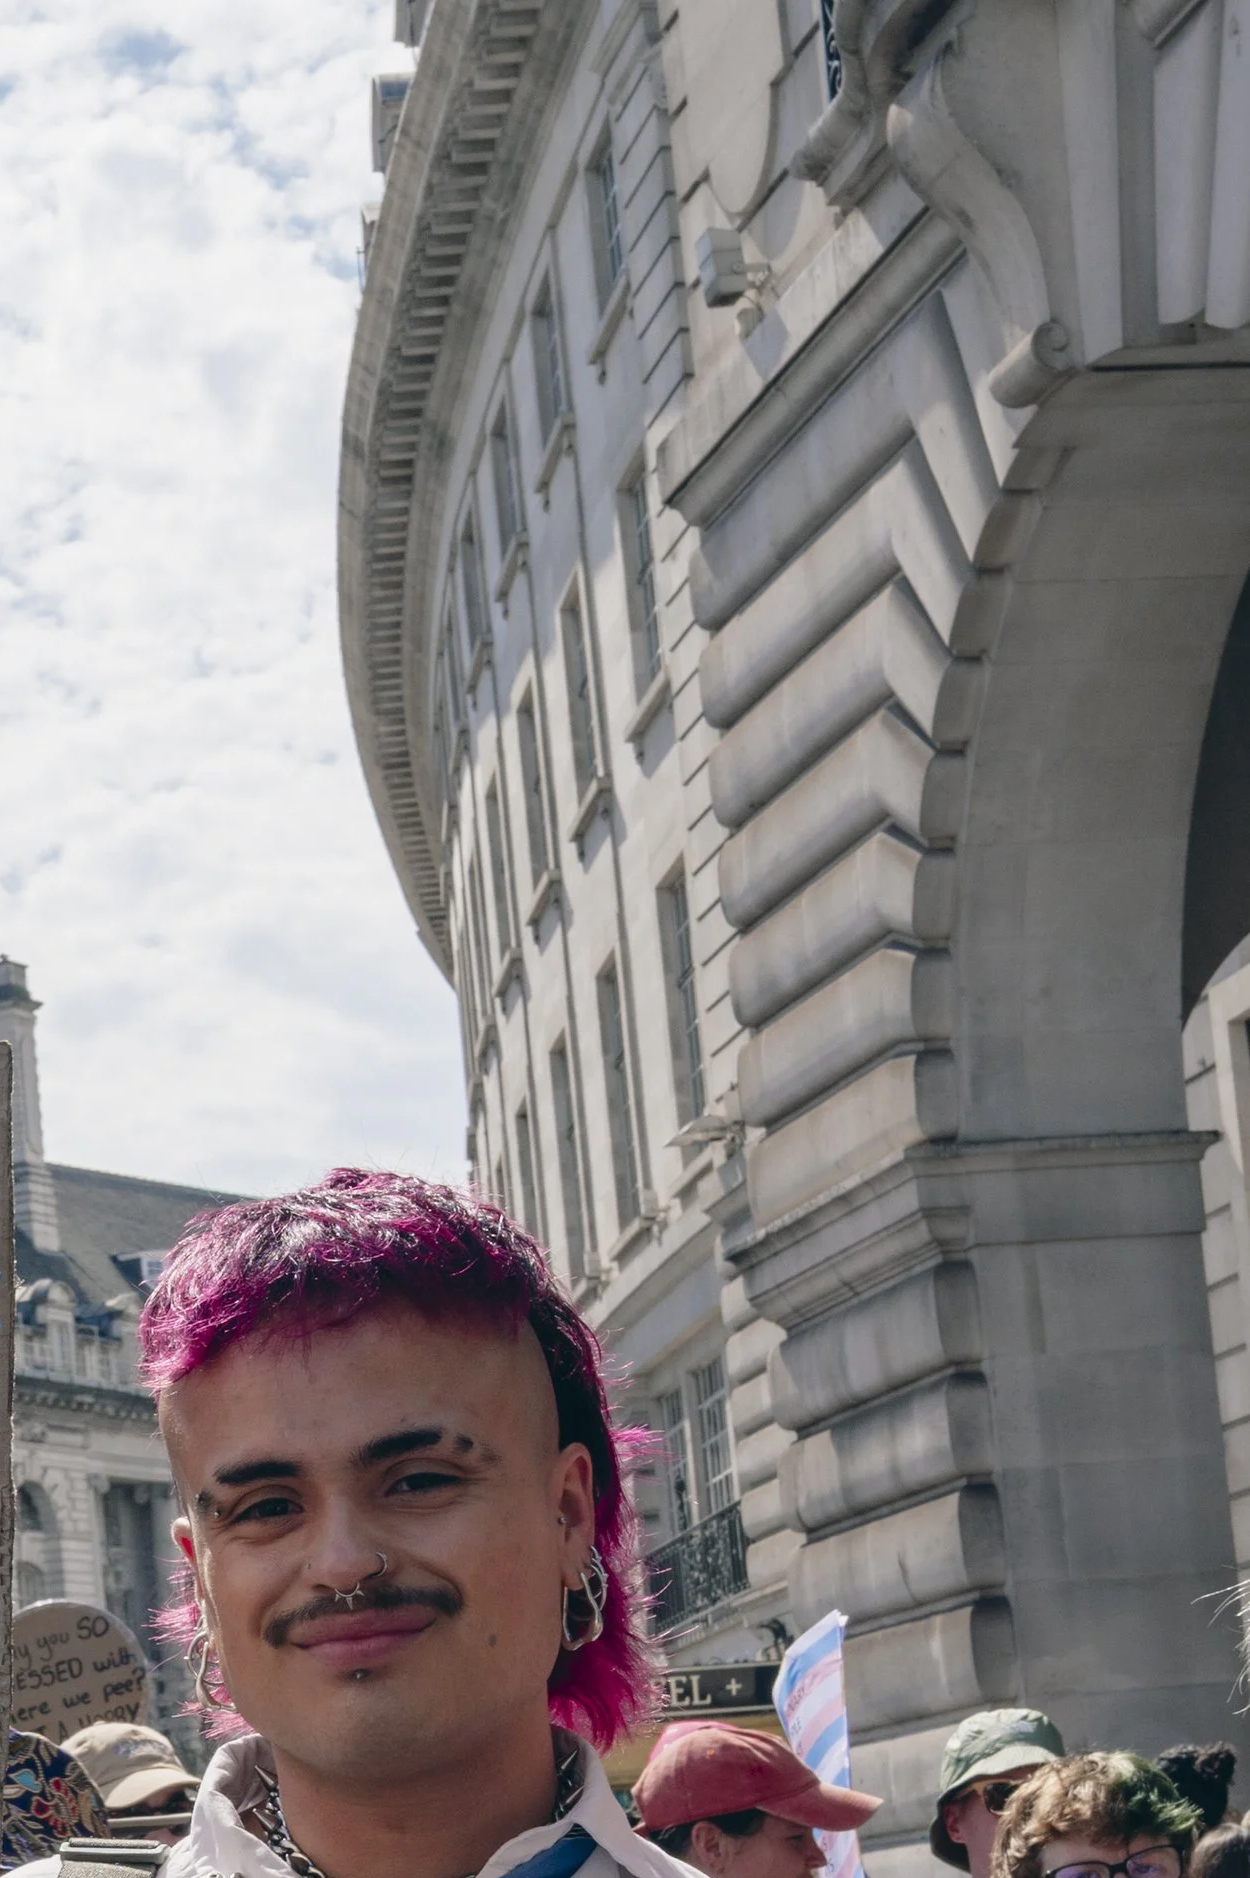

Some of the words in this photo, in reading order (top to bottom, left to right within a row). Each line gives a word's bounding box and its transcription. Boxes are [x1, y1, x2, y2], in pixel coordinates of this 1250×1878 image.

[37, 1631, 70, 1662] you
[77, 1615, 109, 1639] SO
[14, 1657, 83, 1691] ESSED
[63, 1691, 92, 1709] we
[103, 1666, 146, 1704] pee?
